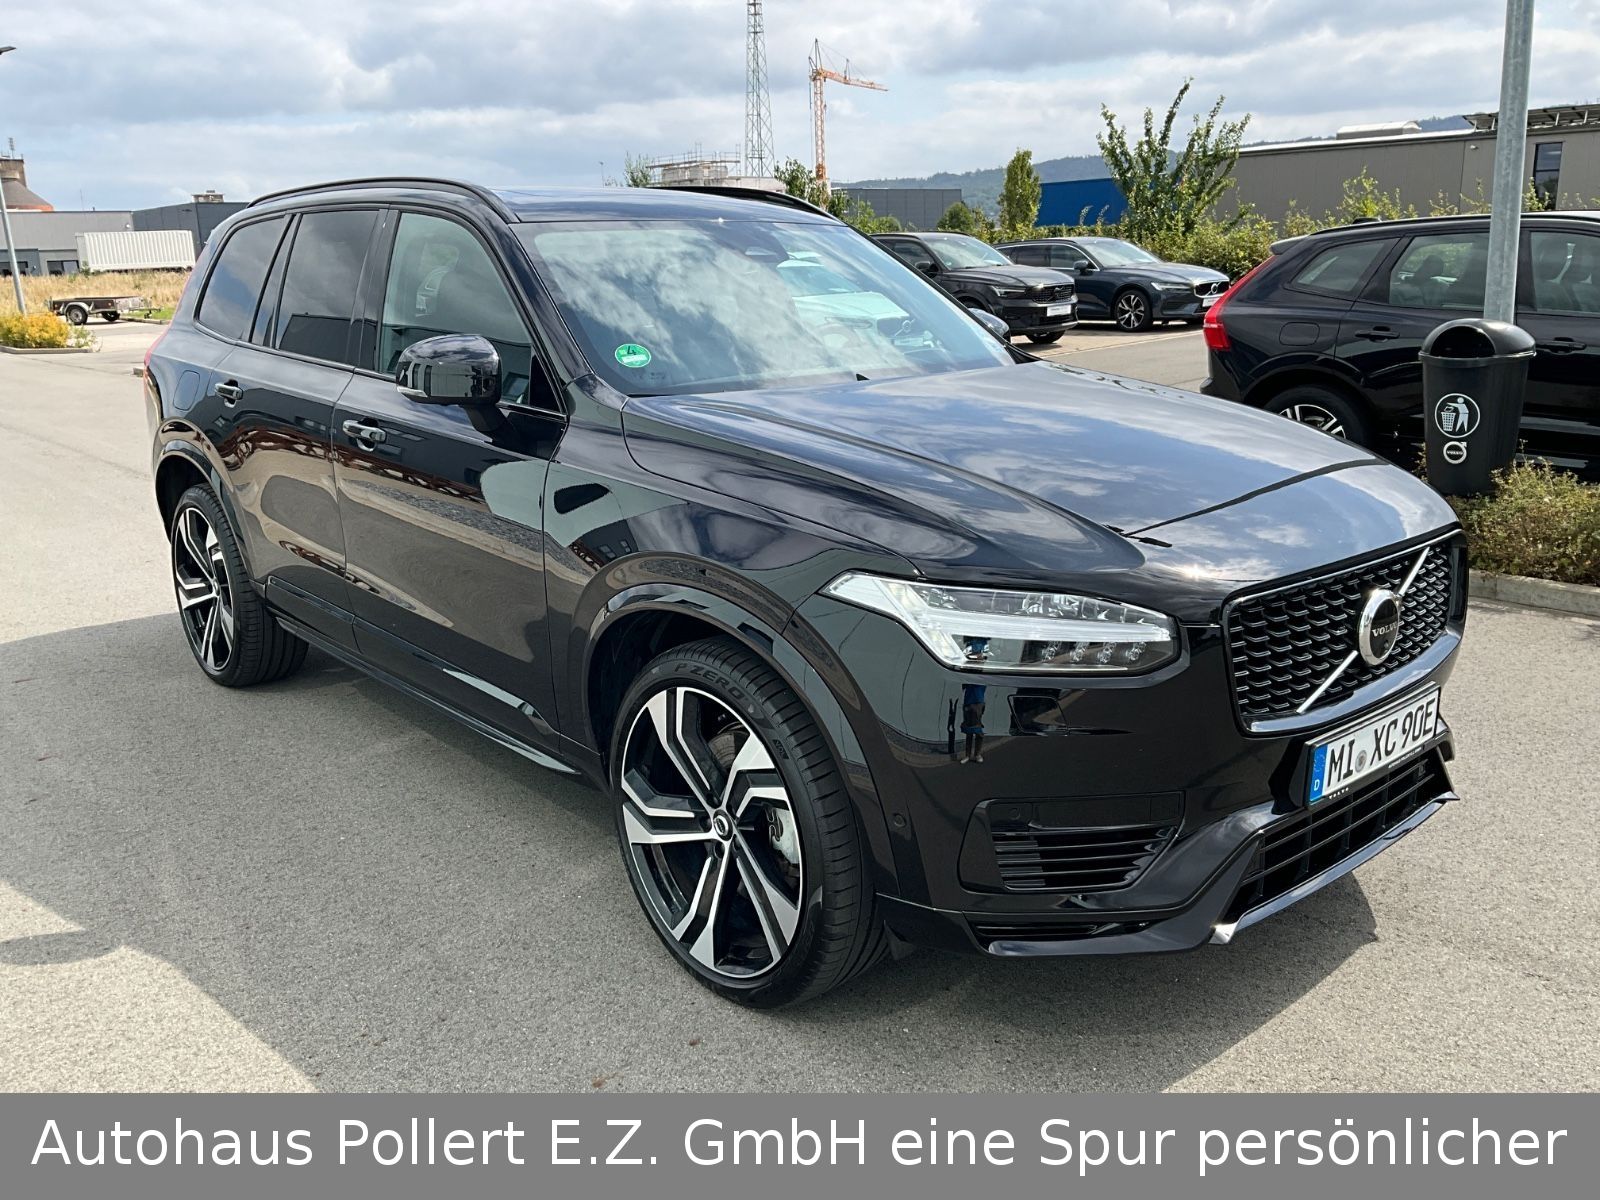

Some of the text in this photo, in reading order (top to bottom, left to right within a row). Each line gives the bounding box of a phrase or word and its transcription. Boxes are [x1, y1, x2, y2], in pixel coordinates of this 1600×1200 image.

[627, 345, 637, 355] 4
[690, 665, 745, 700] ZERO
[1327, 738, 1356, 788] MI
[1370, 718, 1399, 766] XC
[1401, 698, 1436, 749] 90E
[1313, 779, 1320, 791] D
